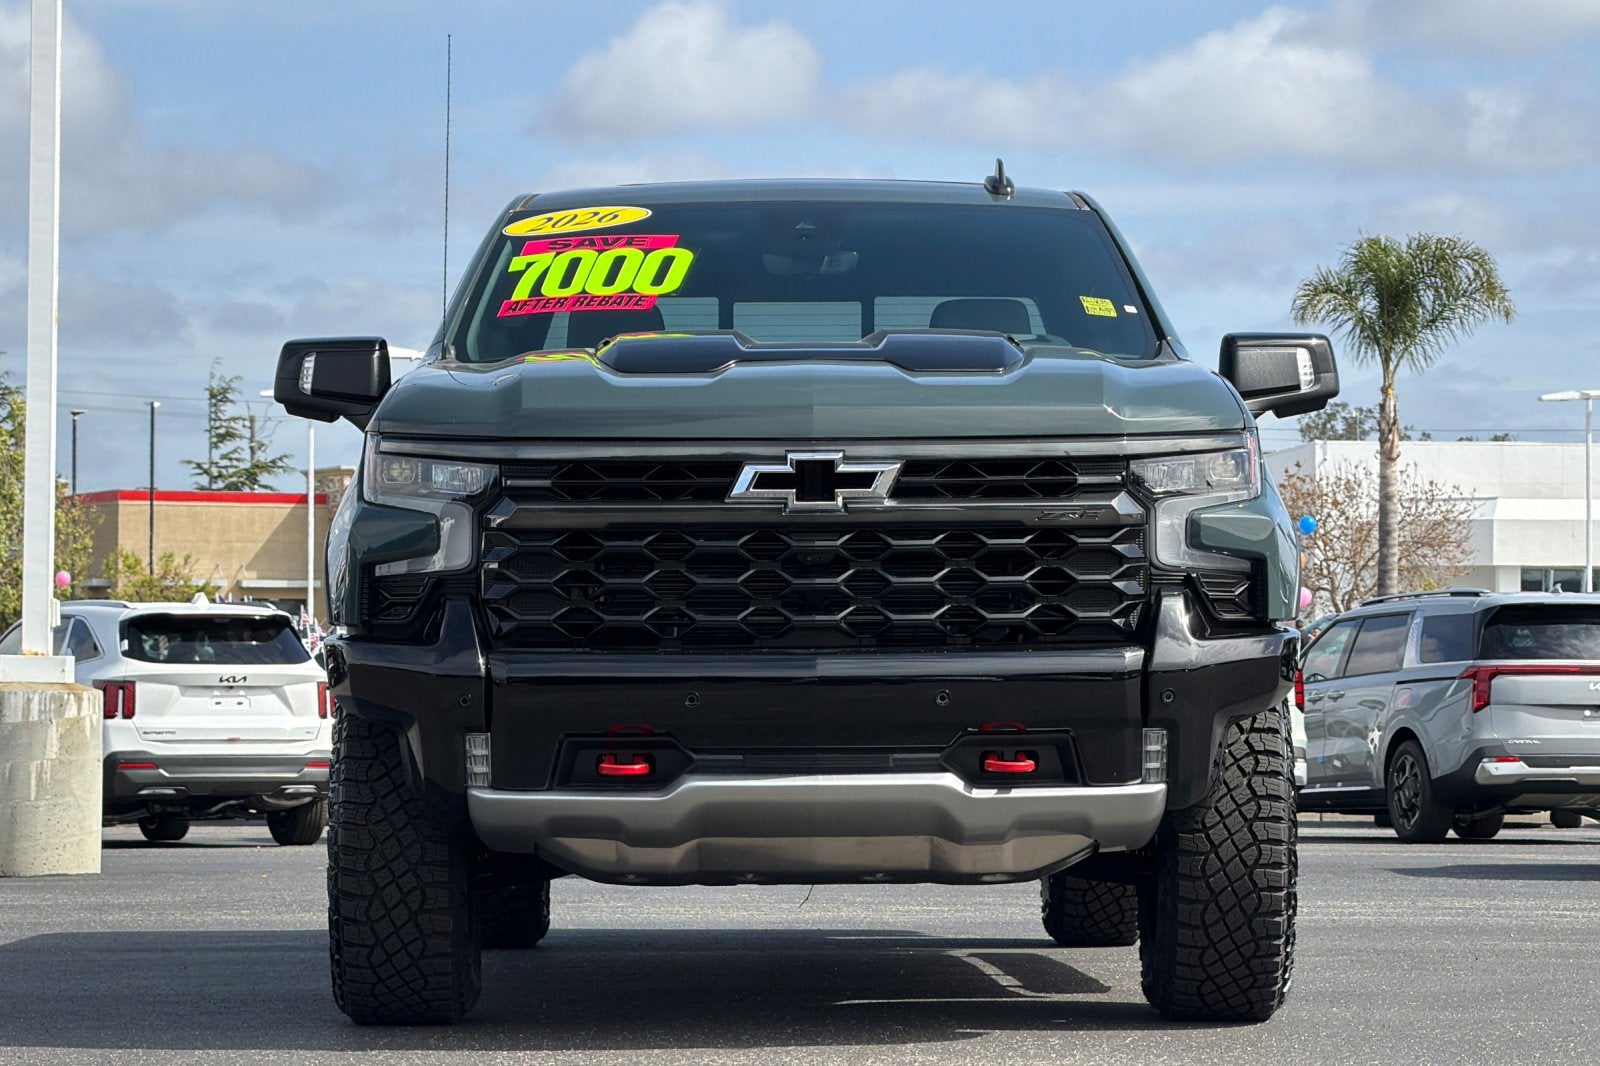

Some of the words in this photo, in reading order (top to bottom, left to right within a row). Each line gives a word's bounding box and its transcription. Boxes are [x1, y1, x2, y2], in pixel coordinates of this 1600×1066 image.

[526, 208, 628, 233] 2026
[547, 236, 650, 250] SAVE
[508, 248, 694, 301] 7000
[506, 297, 569, 314] AFTER
[572, 295, 650, 310] REBATE
